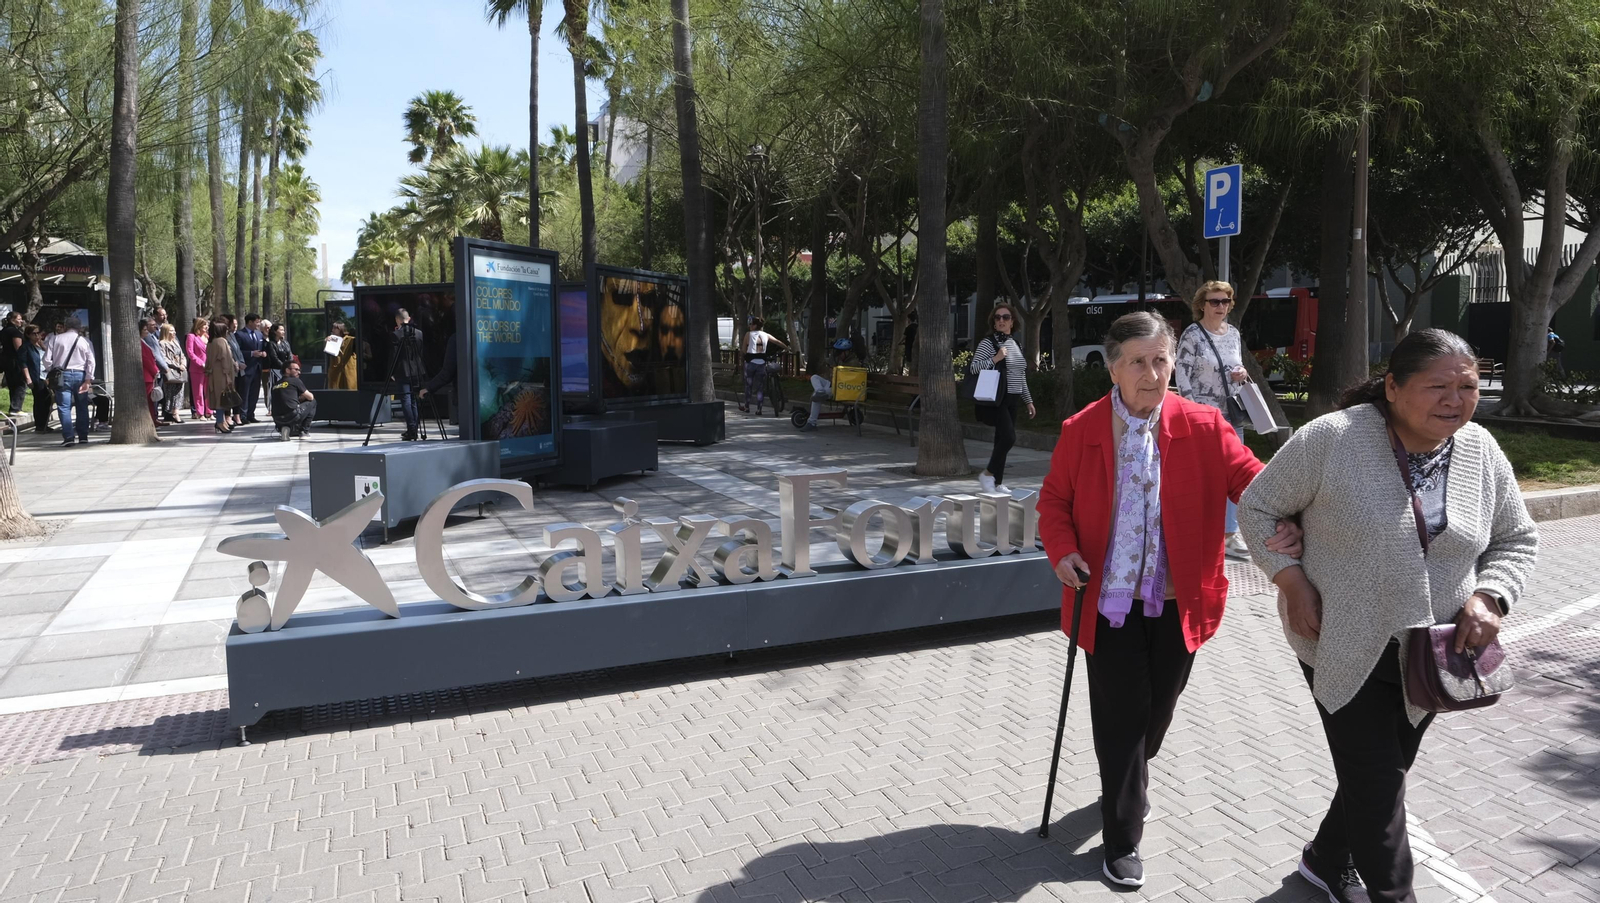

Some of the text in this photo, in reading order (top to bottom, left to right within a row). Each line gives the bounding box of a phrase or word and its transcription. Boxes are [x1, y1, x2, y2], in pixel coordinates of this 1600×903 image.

[1210, 172, 1231, 210] P
[476, 286, 512, 299] COLORES
[476, 298, 521, 311] DEL MUNDO
[1086, 305, 1103, 315] alsa
[477, 320, 521, 332] COLORS OF
[477, 332, 521, 344] THE WORLD
